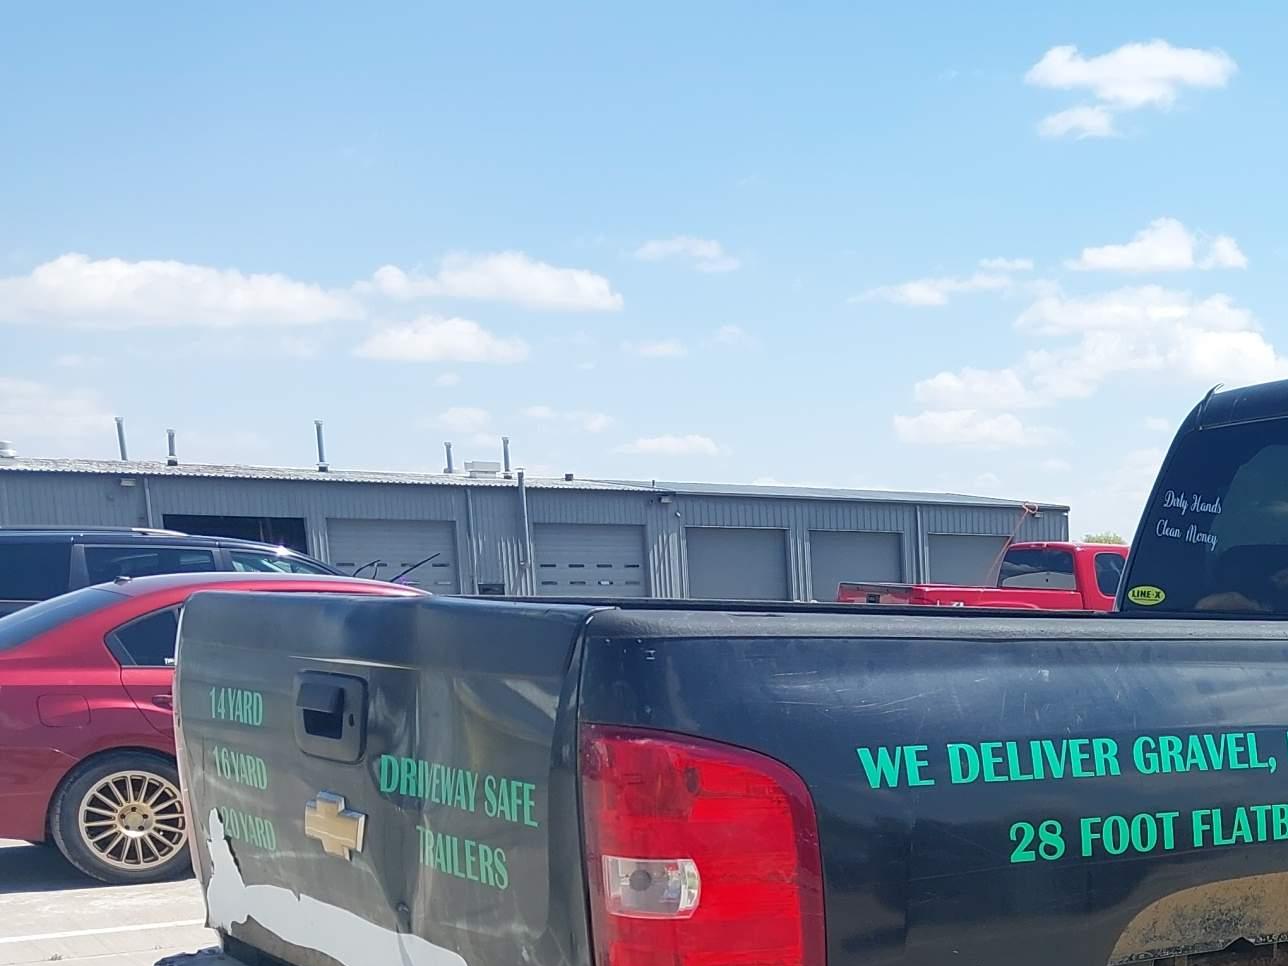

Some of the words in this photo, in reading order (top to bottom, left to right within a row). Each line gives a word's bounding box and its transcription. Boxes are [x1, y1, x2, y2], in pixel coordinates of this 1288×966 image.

[1163, 490, 1188, 515] Dirty
[1190, 494, 1222, 514] Hands
[1156, 519, 1181, 539] Clean
[1185, 524, 1217, 551] Money
[857, 745, 935, 789] WE
[947, 738, 1121, 784] DELIVER
[1134, 732, 1277, 775] GRAVEL,
[379, 753, 478, 812] DRIVEWAY
[484, 774, 539, 828] SAFE
[416, 825, 509, 890] TRAILERS
[1010, 819, 1066, 864] 28
[1080, 811, 1180, 857] FOOT
